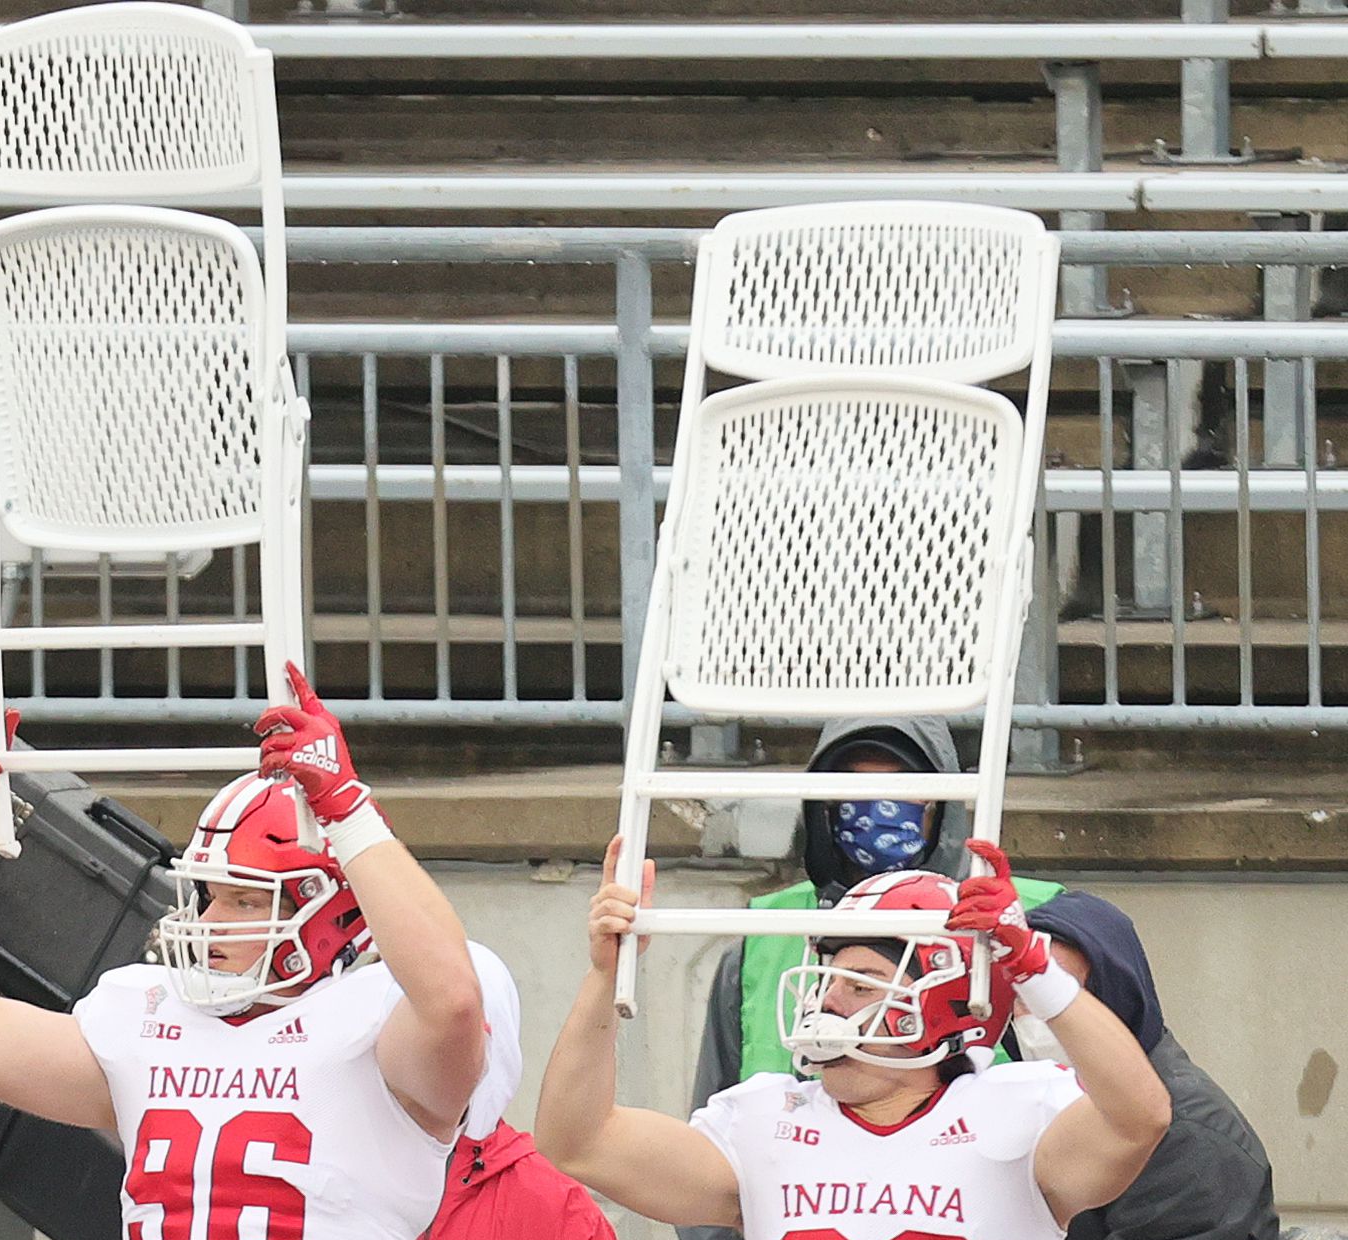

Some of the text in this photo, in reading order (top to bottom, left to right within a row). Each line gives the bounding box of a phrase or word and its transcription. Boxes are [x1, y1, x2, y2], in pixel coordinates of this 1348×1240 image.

[292, 751, 340, 774] adidas
[268, 1033, 308, 1044] adidas
[148, 1066, 300, 1100] INDIANA
[930, 1131, 977, 1146] adidas
[781, 1182, 965, 1223] INDIANA
